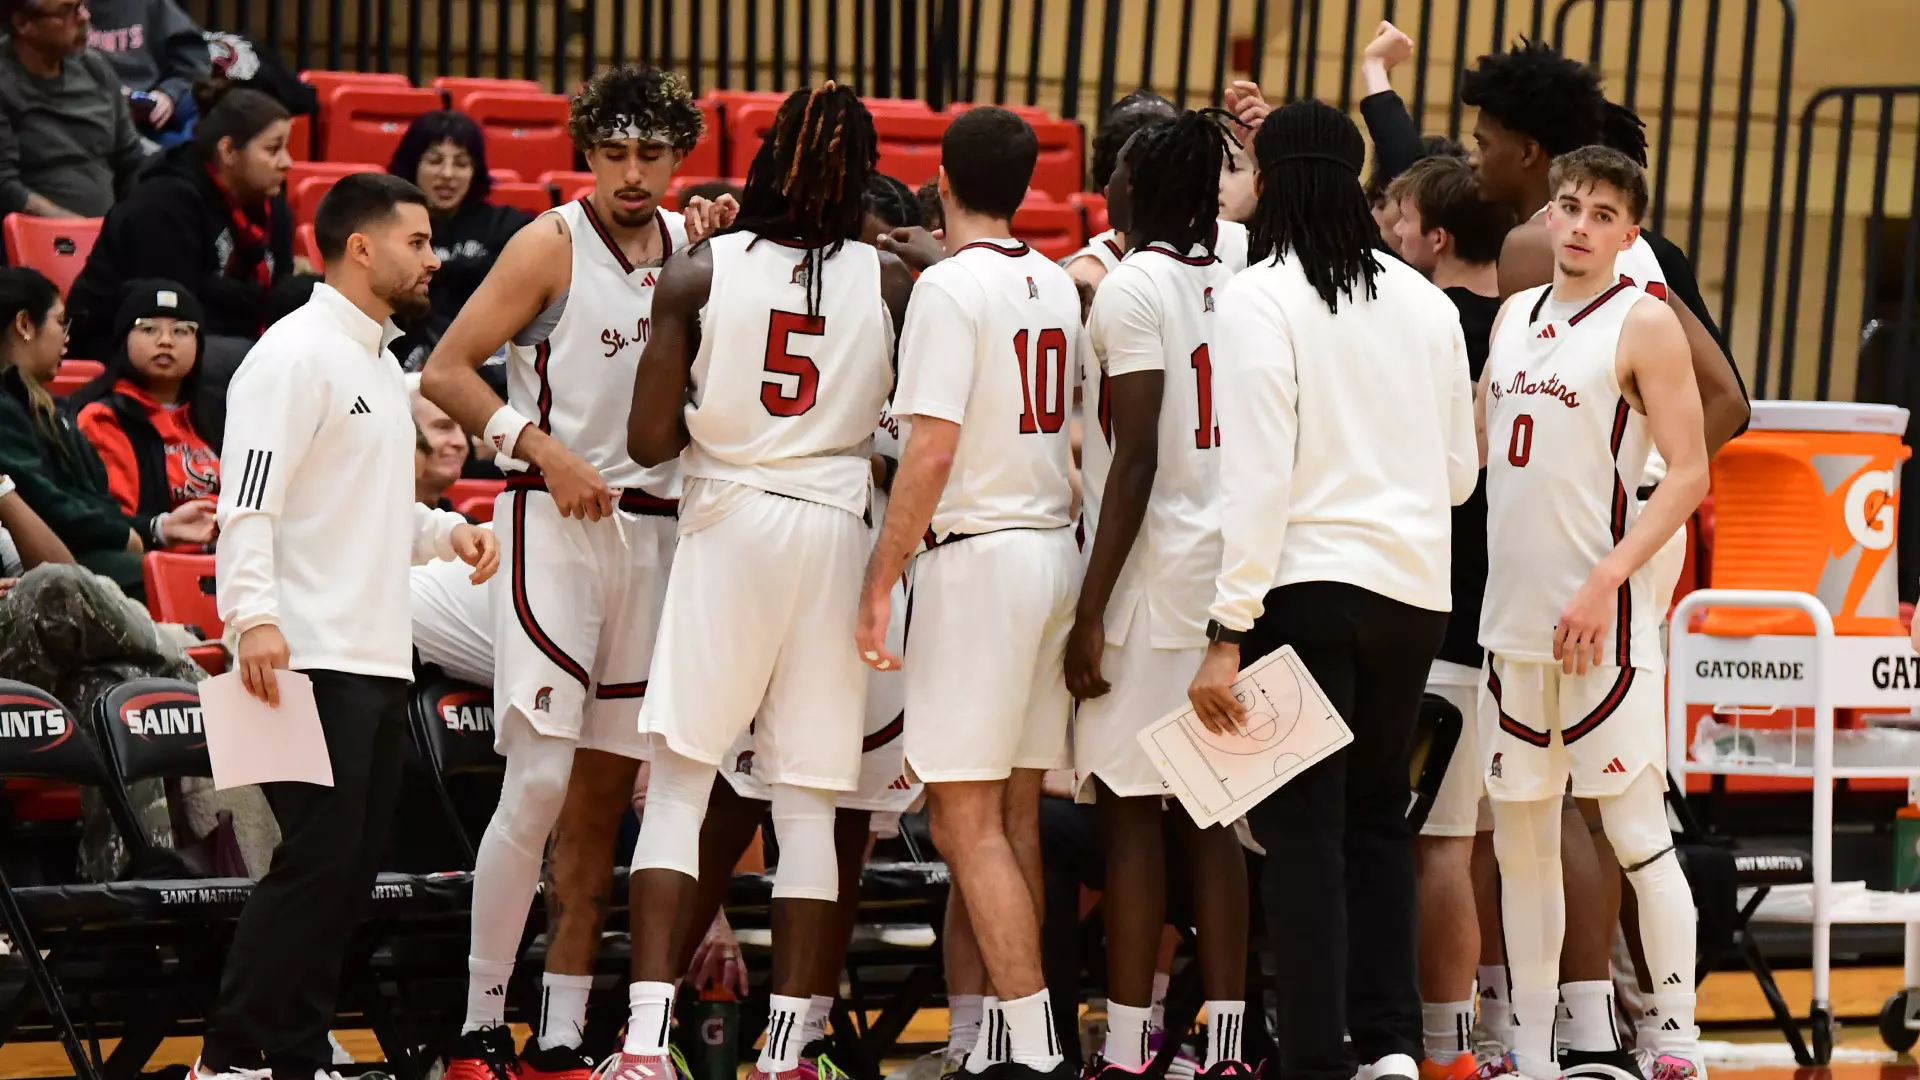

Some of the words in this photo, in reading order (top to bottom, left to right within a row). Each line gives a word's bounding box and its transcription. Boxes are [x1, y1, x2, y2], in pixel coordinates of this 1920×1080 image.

[600, 328, 629, 358] St.
[760, 308, 826, 417] 5
[1012, 328, 1067, 434] 10
[1190, 342, 1221, 449] 1
[1505, 370, 1580, 408] Martins
[1508, 414, 1534, 467] 0
[1844, 470, 1895, 550] G
[1695, 660, 1804, 681] GATORADE
[0, 708, 66, 738] INTS
[160, 889, 197, 904] SAINT
